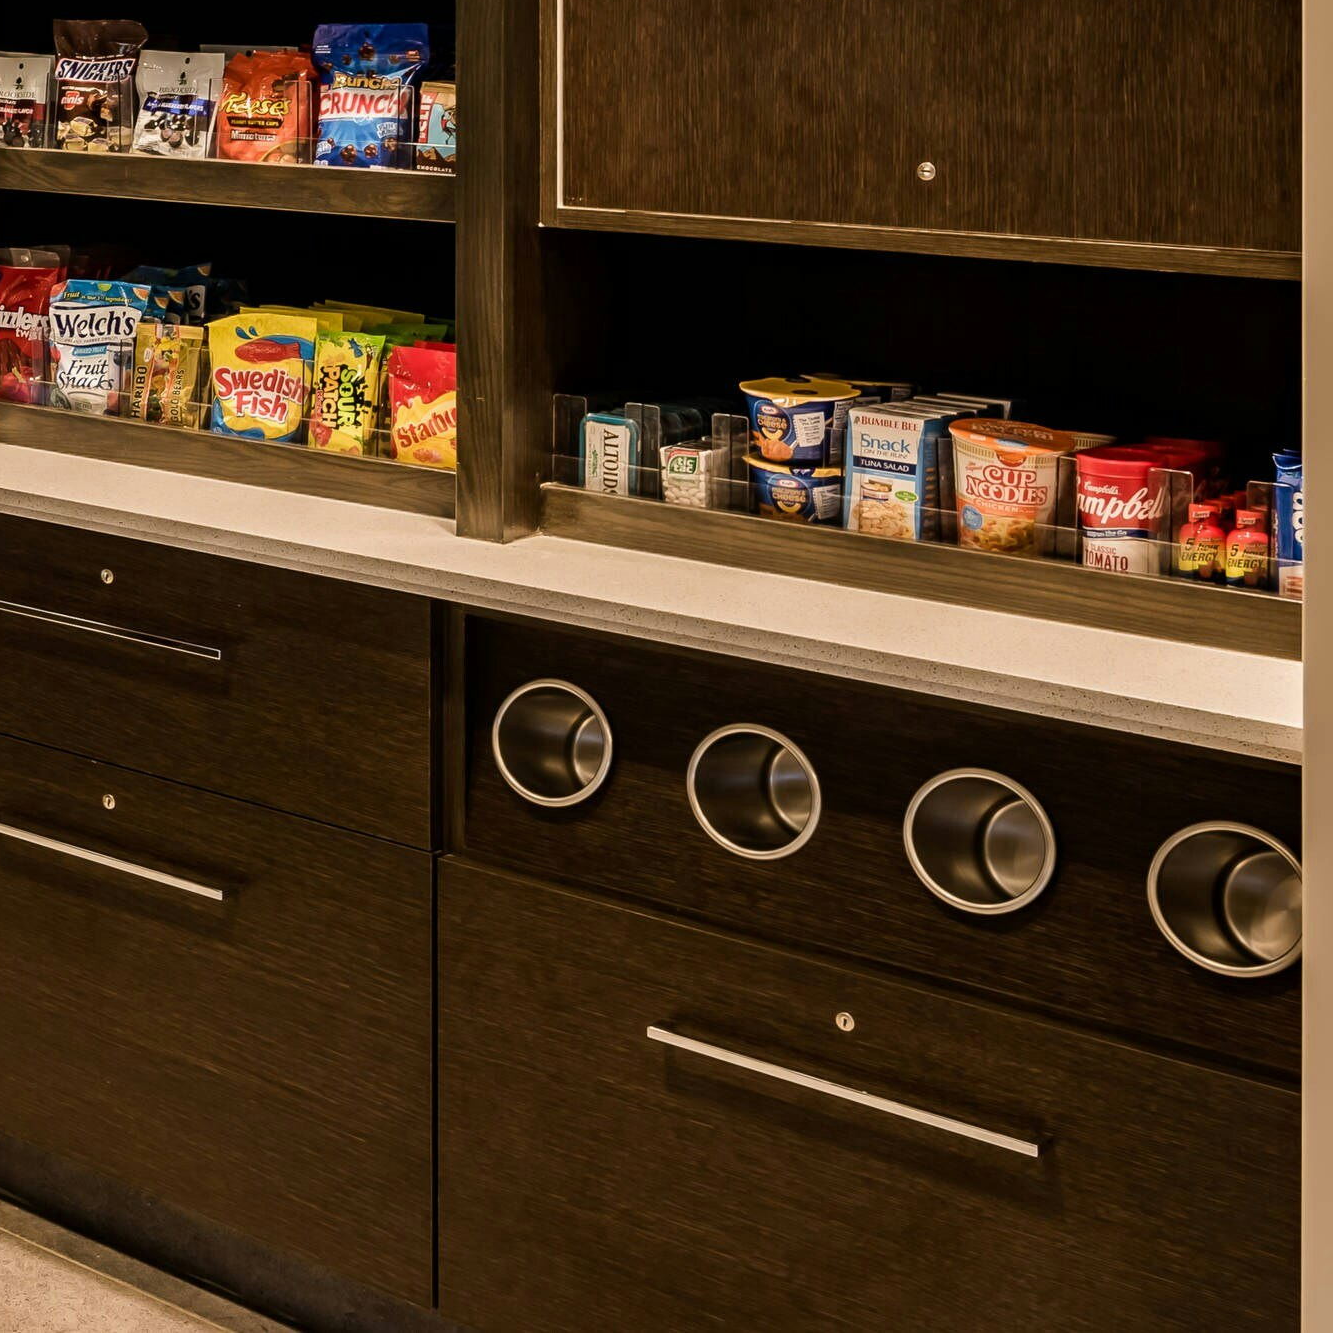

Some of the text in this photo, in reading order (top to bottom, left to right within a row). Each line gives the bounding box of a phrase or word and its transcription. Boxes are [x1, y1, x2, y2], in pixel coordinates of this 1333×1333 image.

[56, 58, 136, 82] SNICKERS
[320, 90, 409, 116] CRUNCH
[230, 129, 278, 141] Miniatures
[416, 164, 453, 173] CHOCOLATE
[62, 291, 81, 300] Fruit
[52, 310, 136, 339] Welch's
[66, 359, 109, 376] Fruit
[57, 371, 115, 391] Snacks
[214, 366, 311, 405] Swedish
[132, 365, 148, 419] HARIBO
[321, 365, 340, 431] PATCH
[339, 368, 358, 431] SOUR
[232, 390, 290, 425] Fish
[396, 406, 457, 449] Starbu
[860, 415, 919, 432] BUMBLE BEE
[860, 433, 911, 455] Snack
[672, 463, 694, 473] tac
[677, 456, 695, 467] tic
[859, 458, 910, 473] TUNA SALAD
[982, 465, 1037, 488] CUP
[965, 477, 1048, 506] NOODLES
[975, 497, 1021, 513] CHICKEN
[1090, 544, 1117, 555] CLASSIC
[1184, 538, 1196, 550] 5
[1230, 543, 1240, 557] 5
[1085, 548, 1129, 573] TOMATO
[1181, 551, 1219, 563] ENERGY
[1227, 558, 1264, 570] ENERGY
